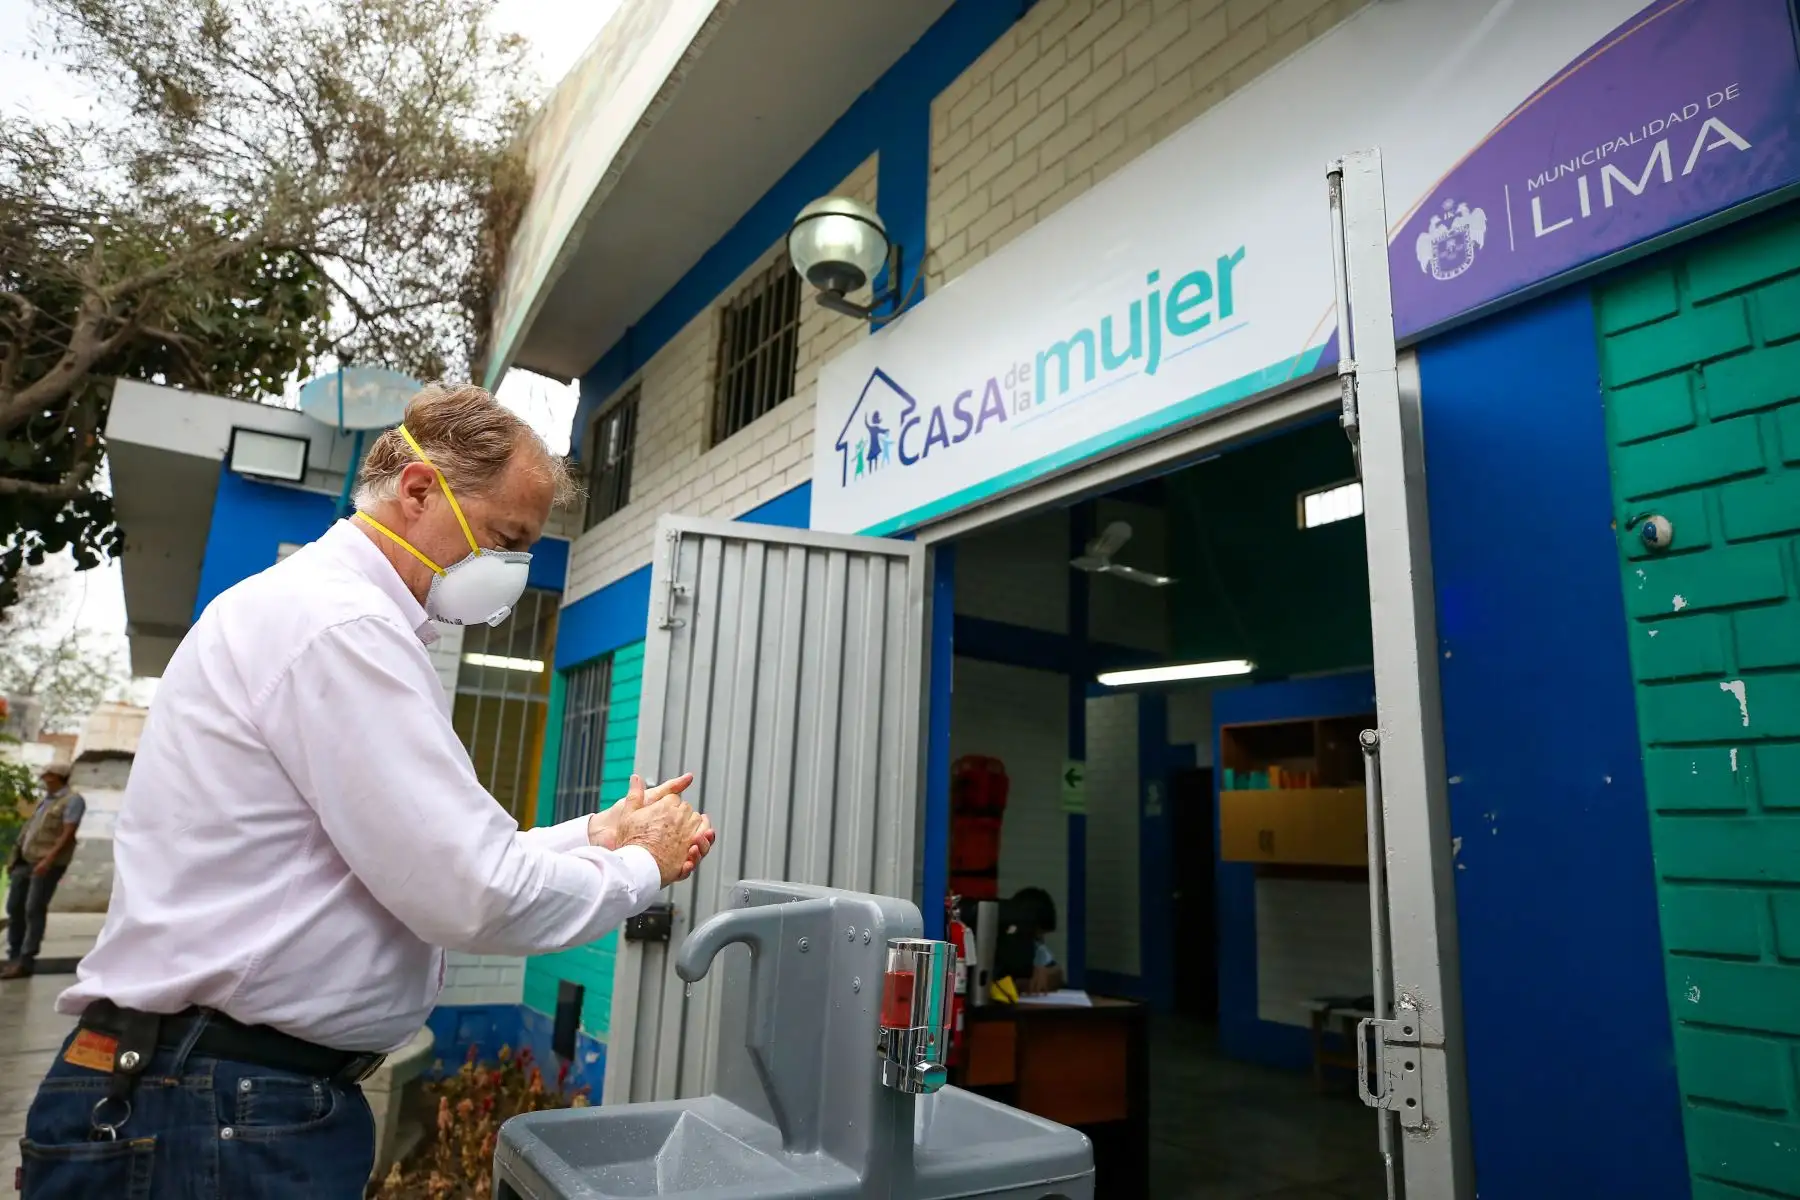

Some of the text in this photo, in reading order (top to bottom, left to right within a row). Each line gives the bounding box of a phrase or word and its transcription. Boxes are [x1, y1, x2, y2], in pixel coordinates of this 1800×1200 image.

[1527, 82, 1741, 192] MUNICIPALIDAD DE
[1531, 116, 1753, 238] LIMA
[898, 245, 1246, 466] CASA de la mujer
